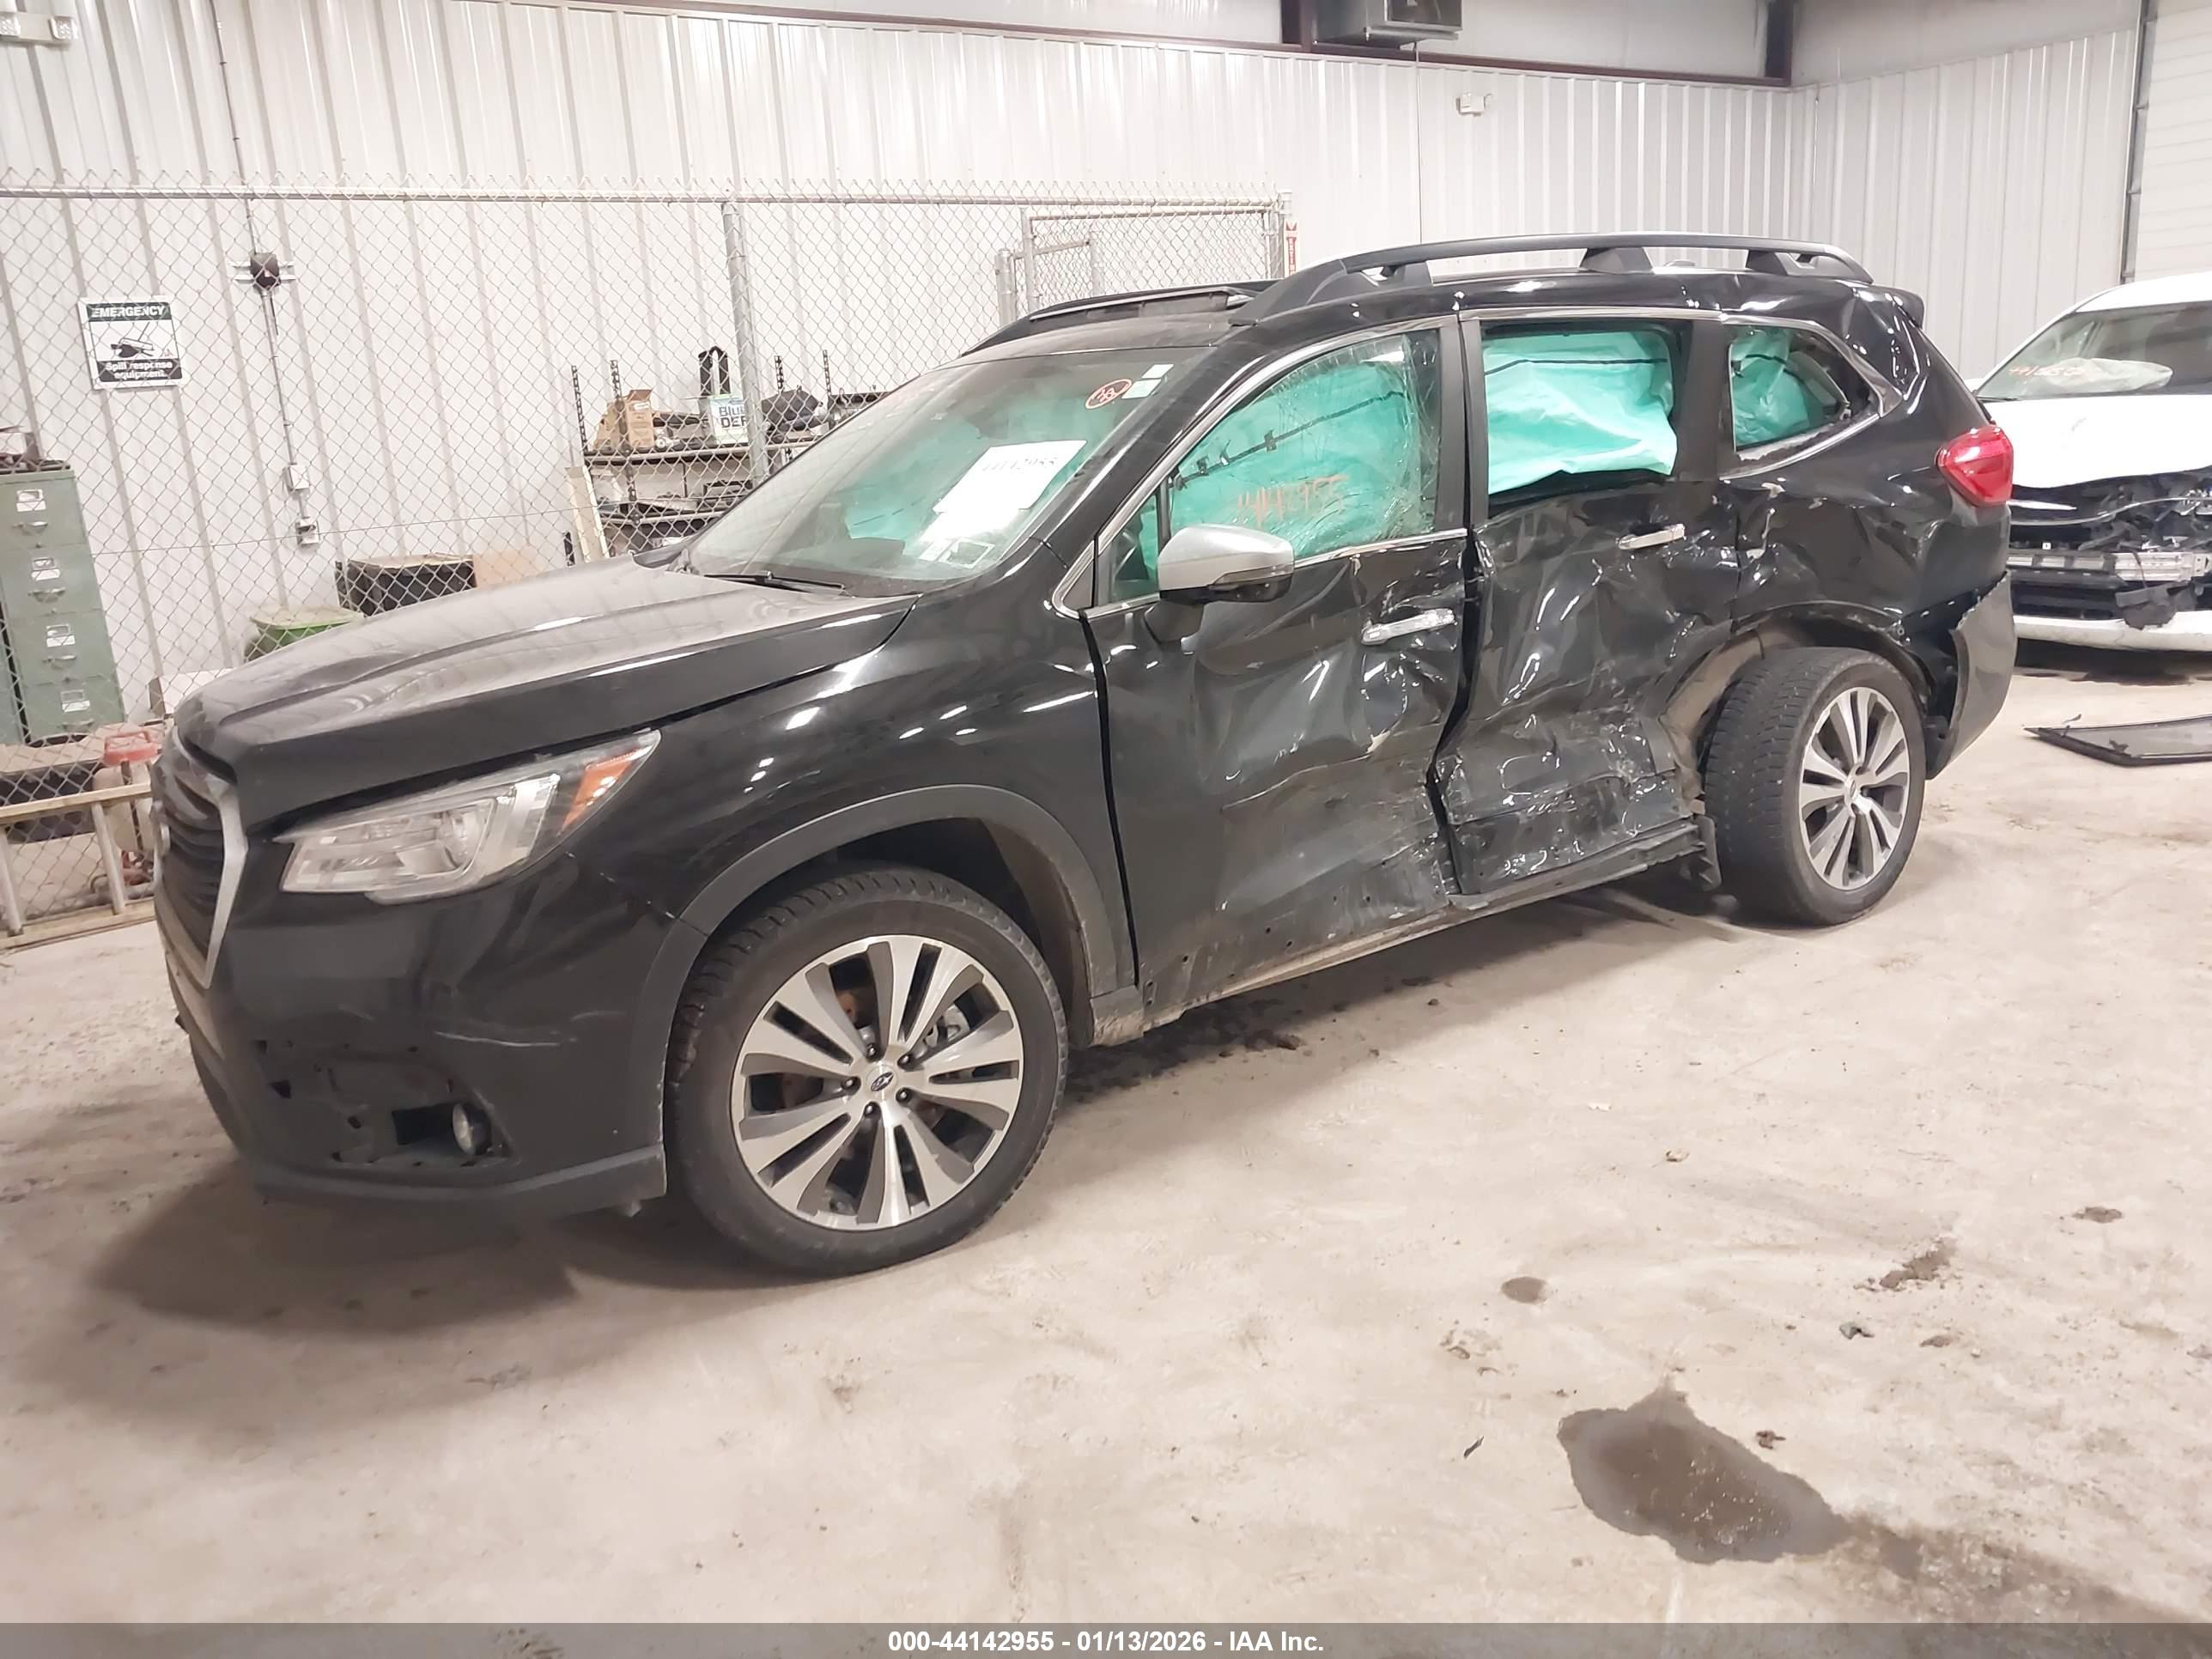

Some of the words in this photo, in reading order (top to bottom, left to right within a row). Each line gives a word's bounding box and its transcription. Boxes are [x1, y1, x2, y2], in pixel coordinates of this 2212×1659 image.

[90, 306, 165, 318] EMERGENCY
[106, 362, 127, 372] Spill
[130, 362, 173, 371] response
